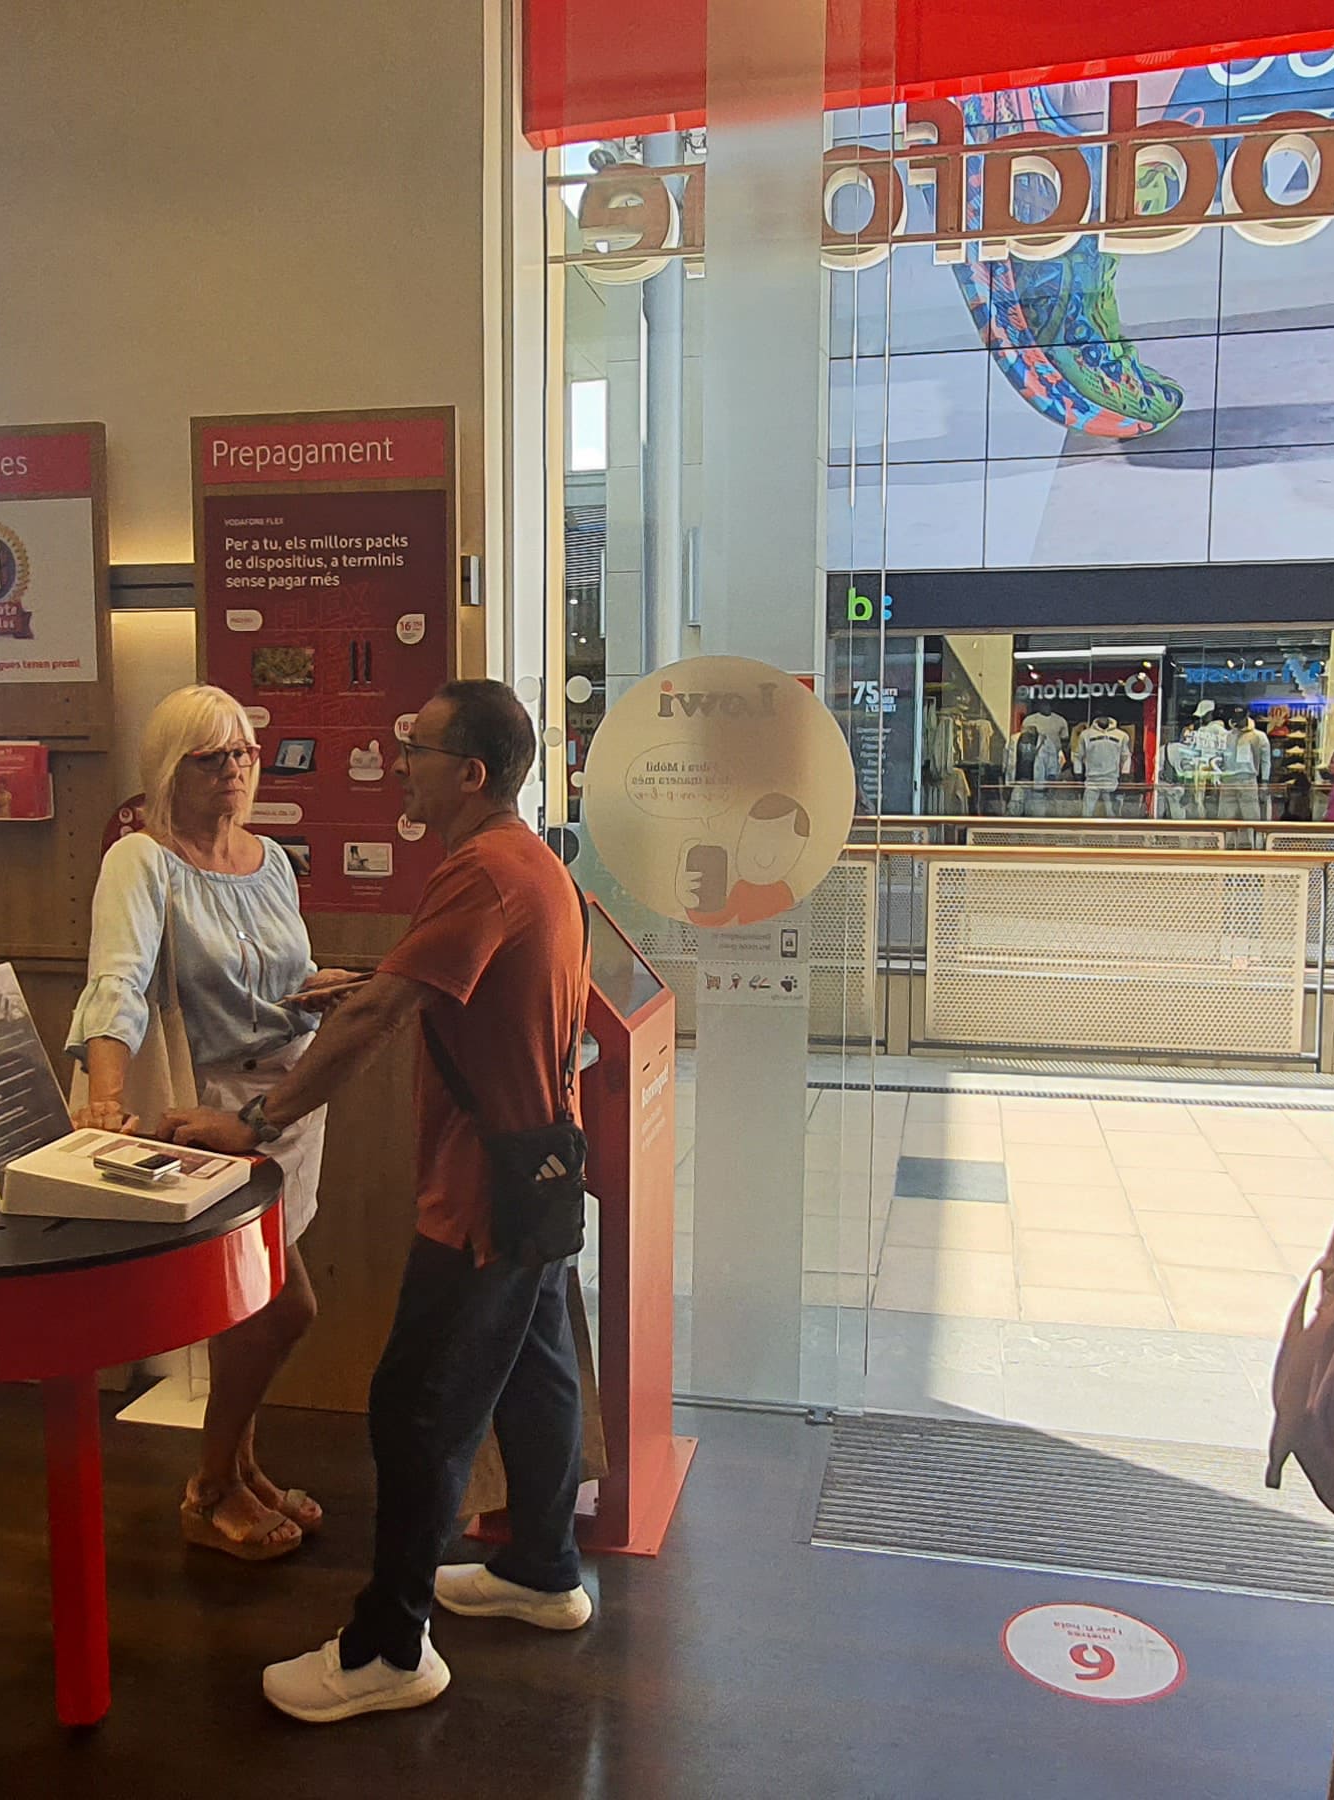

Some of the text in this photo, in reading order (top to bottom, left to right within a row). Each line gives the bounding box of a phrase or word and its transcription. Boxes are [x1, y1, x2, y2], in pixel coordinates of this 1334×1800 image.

[212, 437, 394, 472] Prepagament
[225, 533, 409, 554] Per a tu, els millors packs
[225, 552, 404, 573] de dispositius, a terminis
[225, 571, 340, 591] sense pagar més
[852, 680, 880, 705] 75
